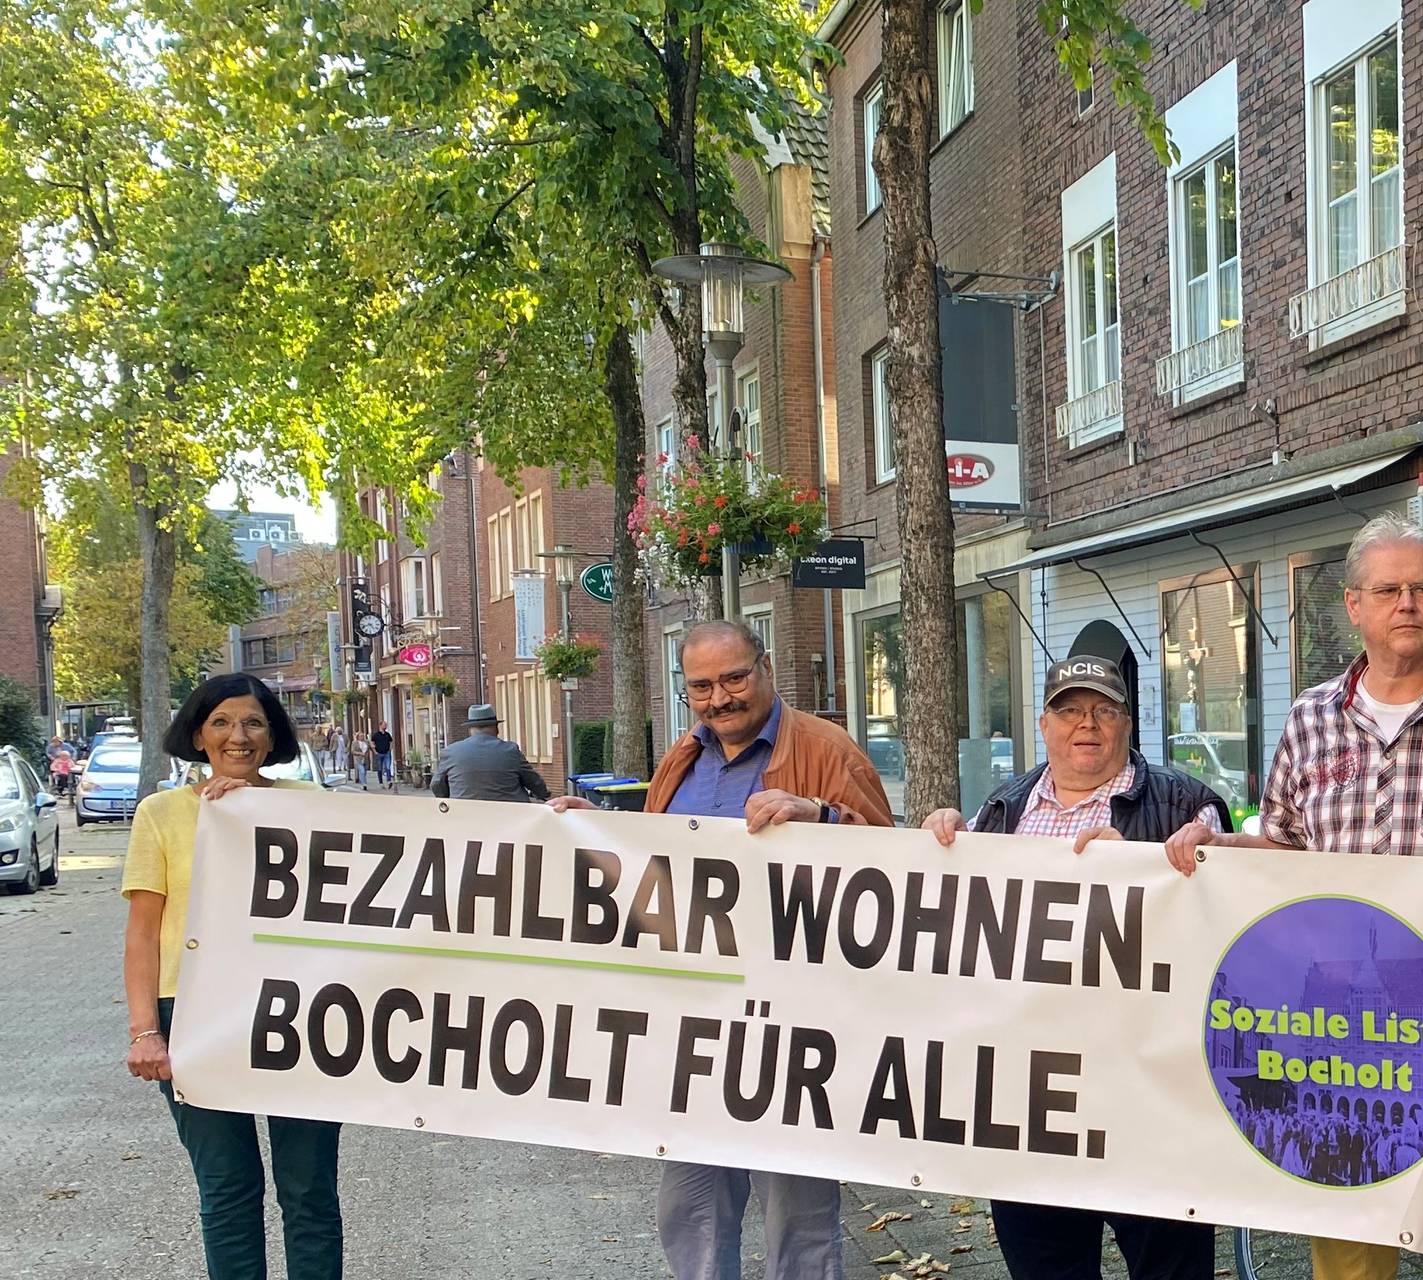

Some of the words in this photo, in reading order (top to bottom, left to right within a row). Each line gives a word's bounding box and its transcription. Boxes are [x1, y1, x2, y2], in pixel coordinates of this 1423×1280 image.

[828, 556, 857, 566] digital
[1059, 662, 1106, 681] NCIS
[250, 826, 740, 957] BEZAHLBAR
[767, 862, 1171, 993] WOHNEN.
[1209, 999, 1350, 1039] Soziale
[250, 978, 649, 1106] BOCHOLT
[670, 1000, 837, 1130] FÜR
[859, 1036, 1107, 1160] ALLE.
[1257, 1050, 1413, 1092] Bocholt
